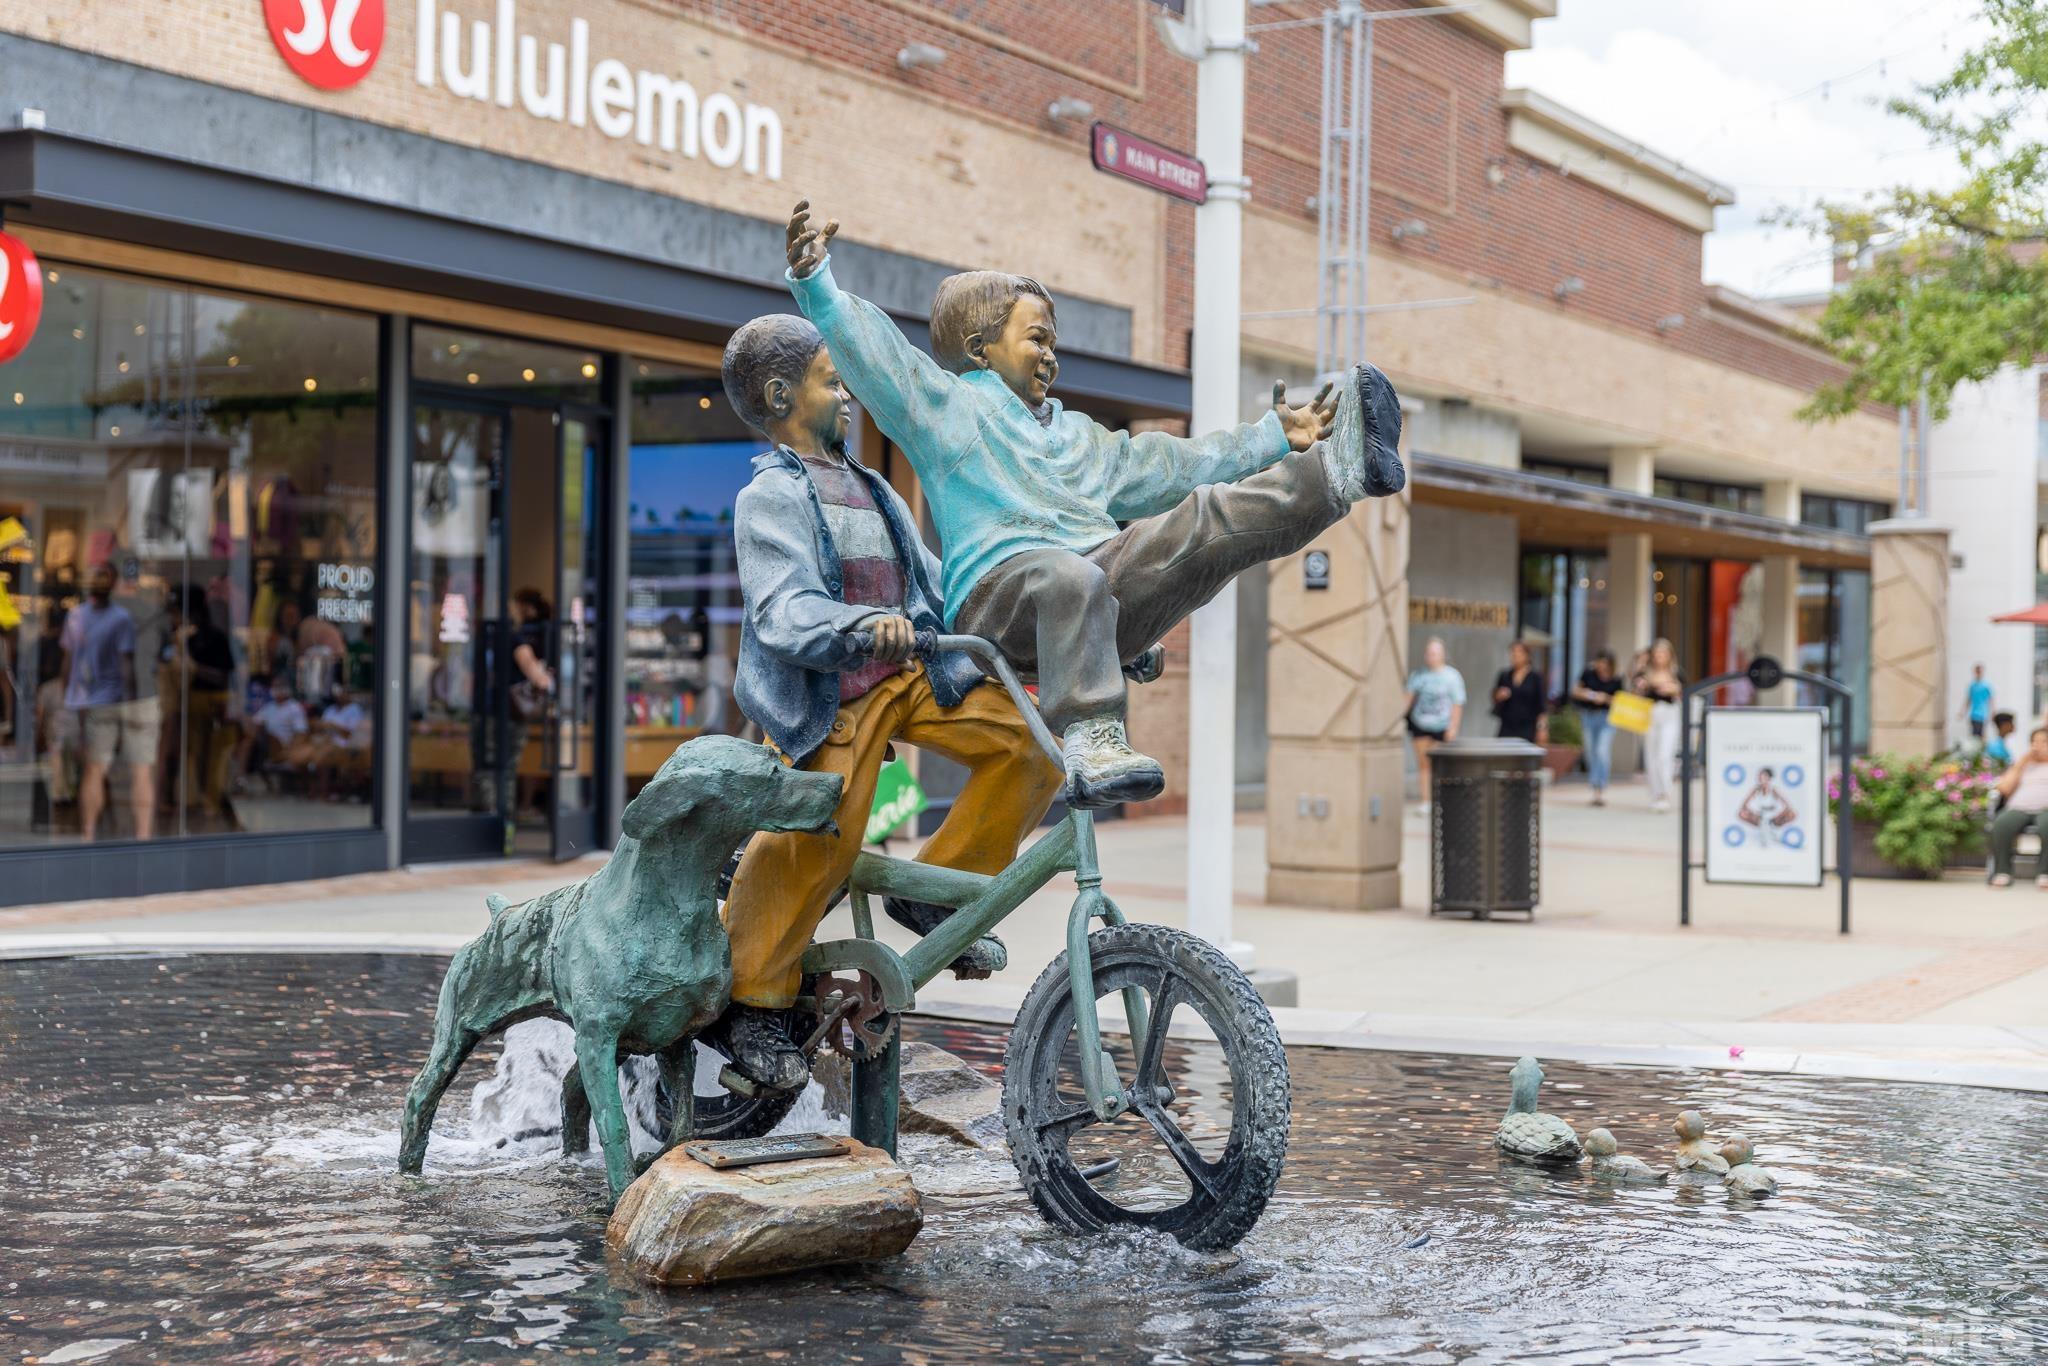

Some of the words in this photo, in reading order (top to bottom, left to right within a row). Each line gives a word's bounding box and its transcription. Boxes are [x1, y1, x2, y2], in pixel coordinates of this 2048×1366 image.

[415, 0, 784, 181] lululemon
[1125, 146, 1158, 175] MAIN
[1158, 159, 1201, 189] STREET
[318, 563, 375, 592] PROUD
[317, 598, 375, 624] PRESENT
